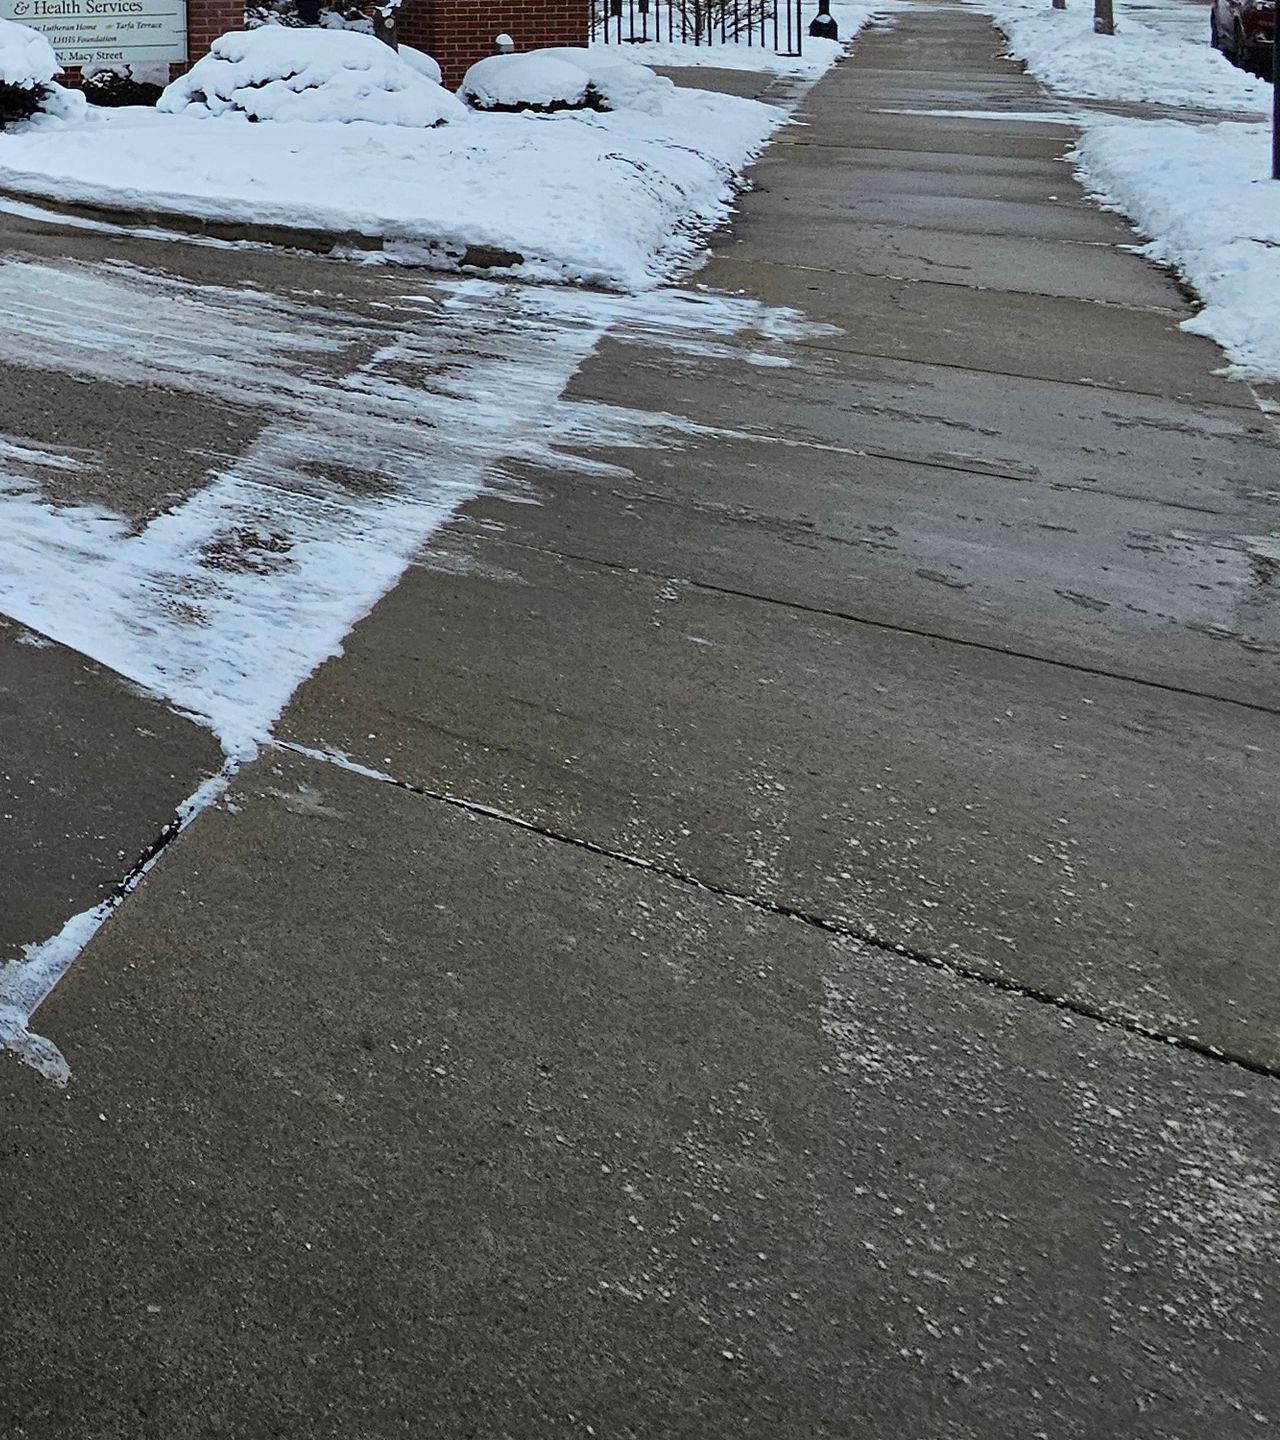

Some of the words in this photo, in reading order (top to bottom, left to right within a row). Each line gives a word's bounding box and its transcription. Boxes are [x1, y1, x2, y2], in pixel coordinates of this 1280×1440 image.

[13, 1, 30, 16] &
[33, 0, 81, 15] Health
[42, 24, 74, 32] Lutheran
[75, 23, 97, 31] Home
[136, 21, 163, 30] Terrace
[77, 35, 117, 43] Foundation
[55, 52, 67, 61] N.
[69, 51, 94, 63] Macy
[96, 51, 124, 61] Street
